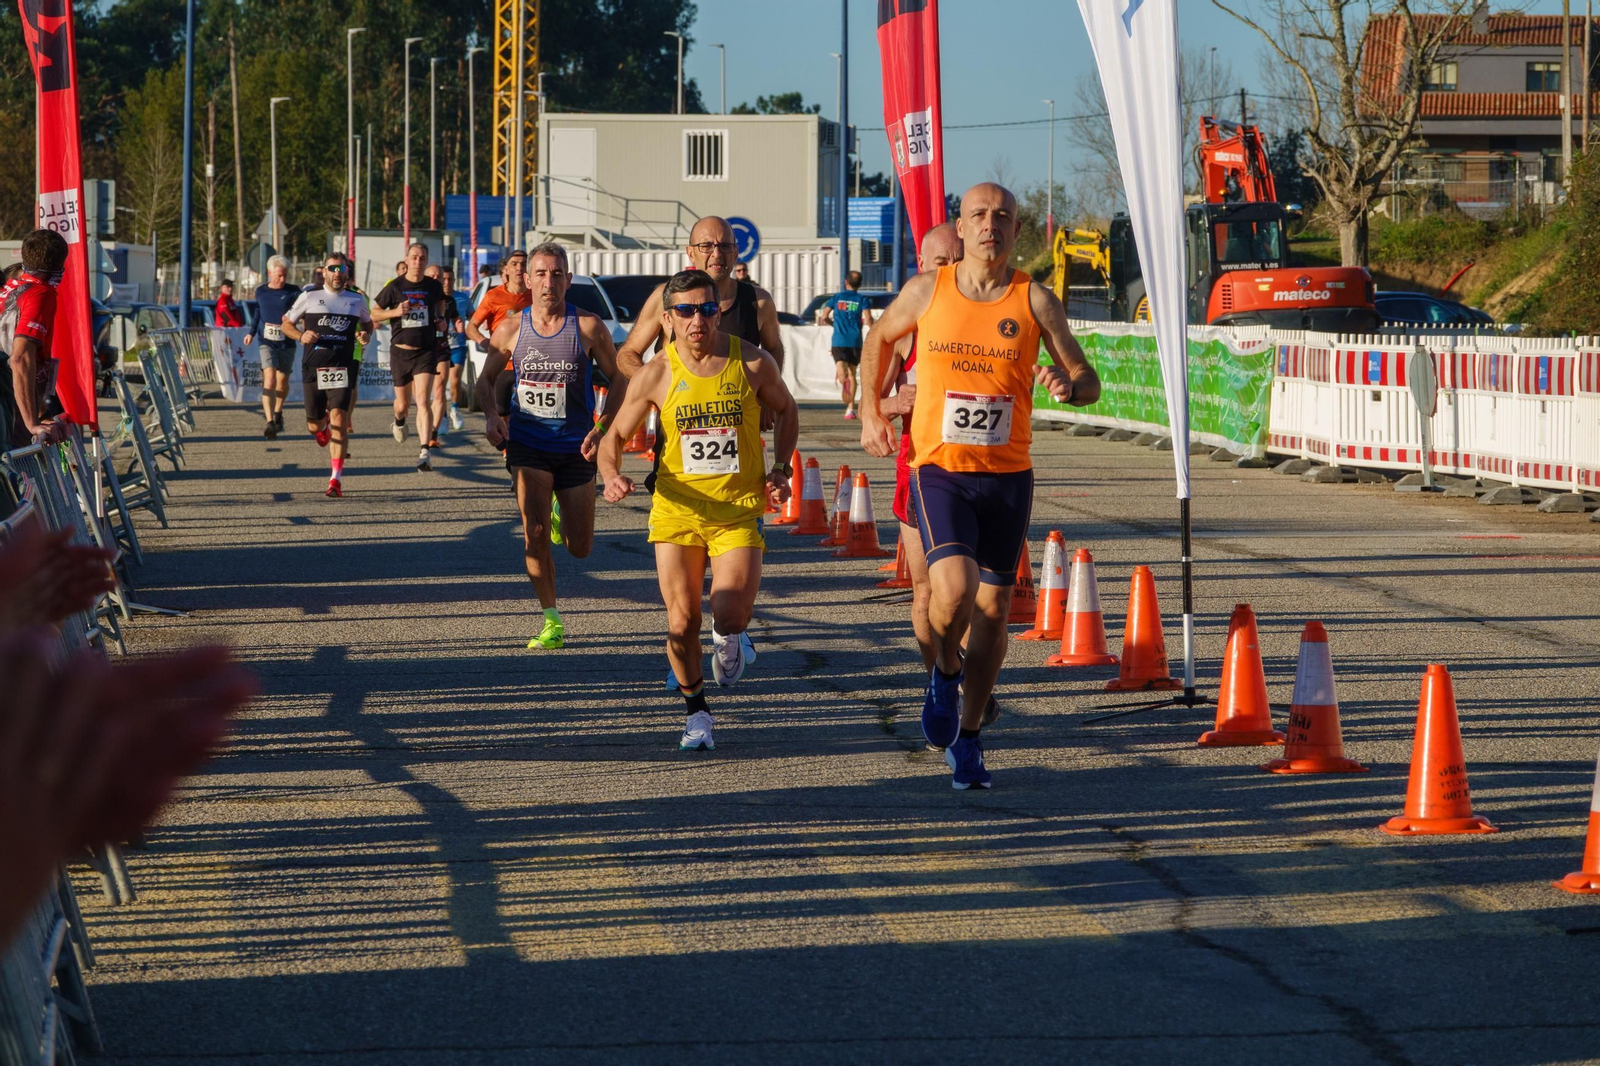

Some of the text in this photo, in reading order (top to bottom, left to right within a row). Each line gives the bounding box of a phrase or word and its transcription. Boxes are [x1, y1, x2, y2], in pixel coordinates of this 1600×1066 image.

[1273, 288, 1331, 301] mateco
[405, 311, 426, 321] 704
[928, 340, 1021, 361] SAMERTOLAMEU
[523, 360, 579, 371] castrelos
[951, 359, 994, 374] MOAÑA
[321, 373, 343, 383] 322
[525, 391, 556, 408] 315
[675, 399, 742, 419] ATHLETICS
[677, 420, 699, 430] SAN
[953, 407, 1003, 431] 327
[690, 440, 738, 461] 324
